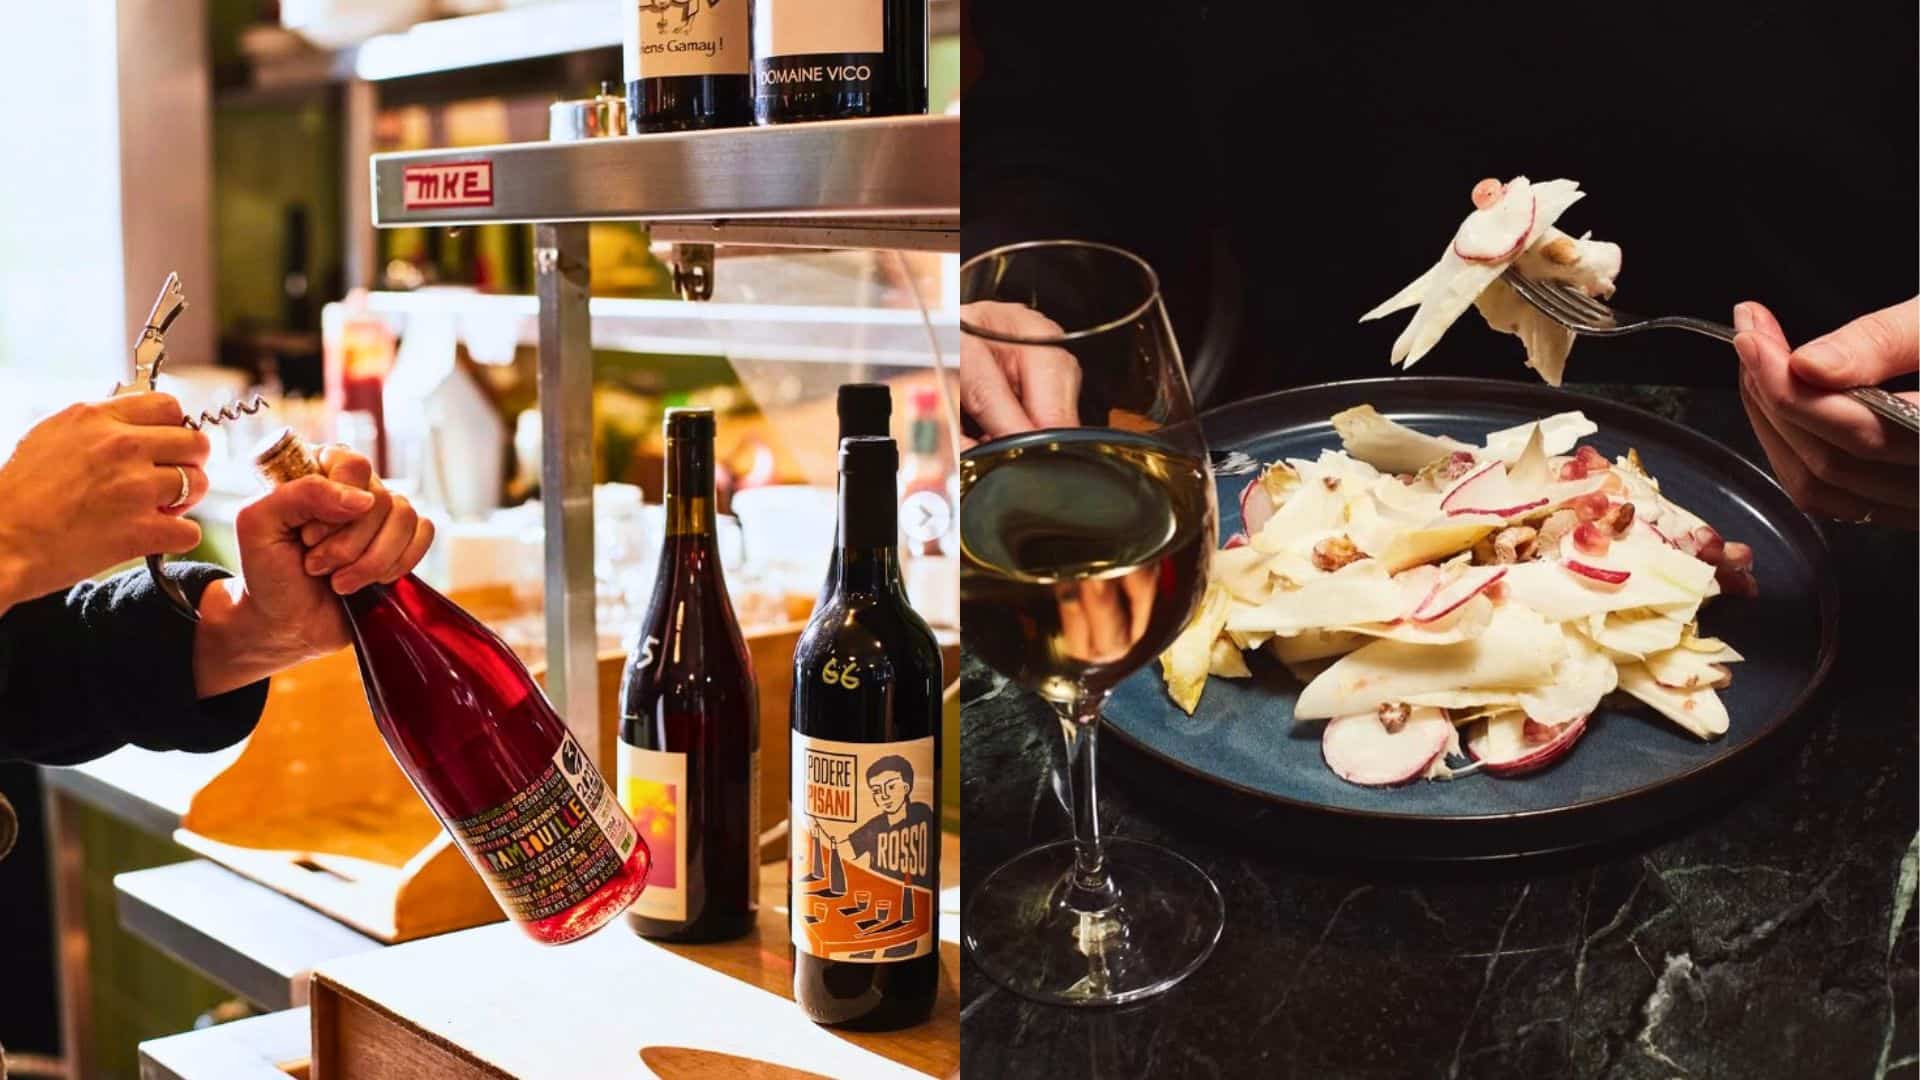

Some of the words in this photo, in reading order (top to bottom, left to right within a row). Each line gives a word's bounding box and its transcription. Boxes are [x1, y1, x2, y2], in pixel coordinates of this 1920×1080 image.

[761, 66, 823, 85] DOMAINE
[827, 65, 871, 81] VICO
[822, 657, 861, 690] 66
[807, 754, 851, 788] PODERE
[807, 783, 851, 818] PISANI
[876, 821, 928, 878] ROSSO
